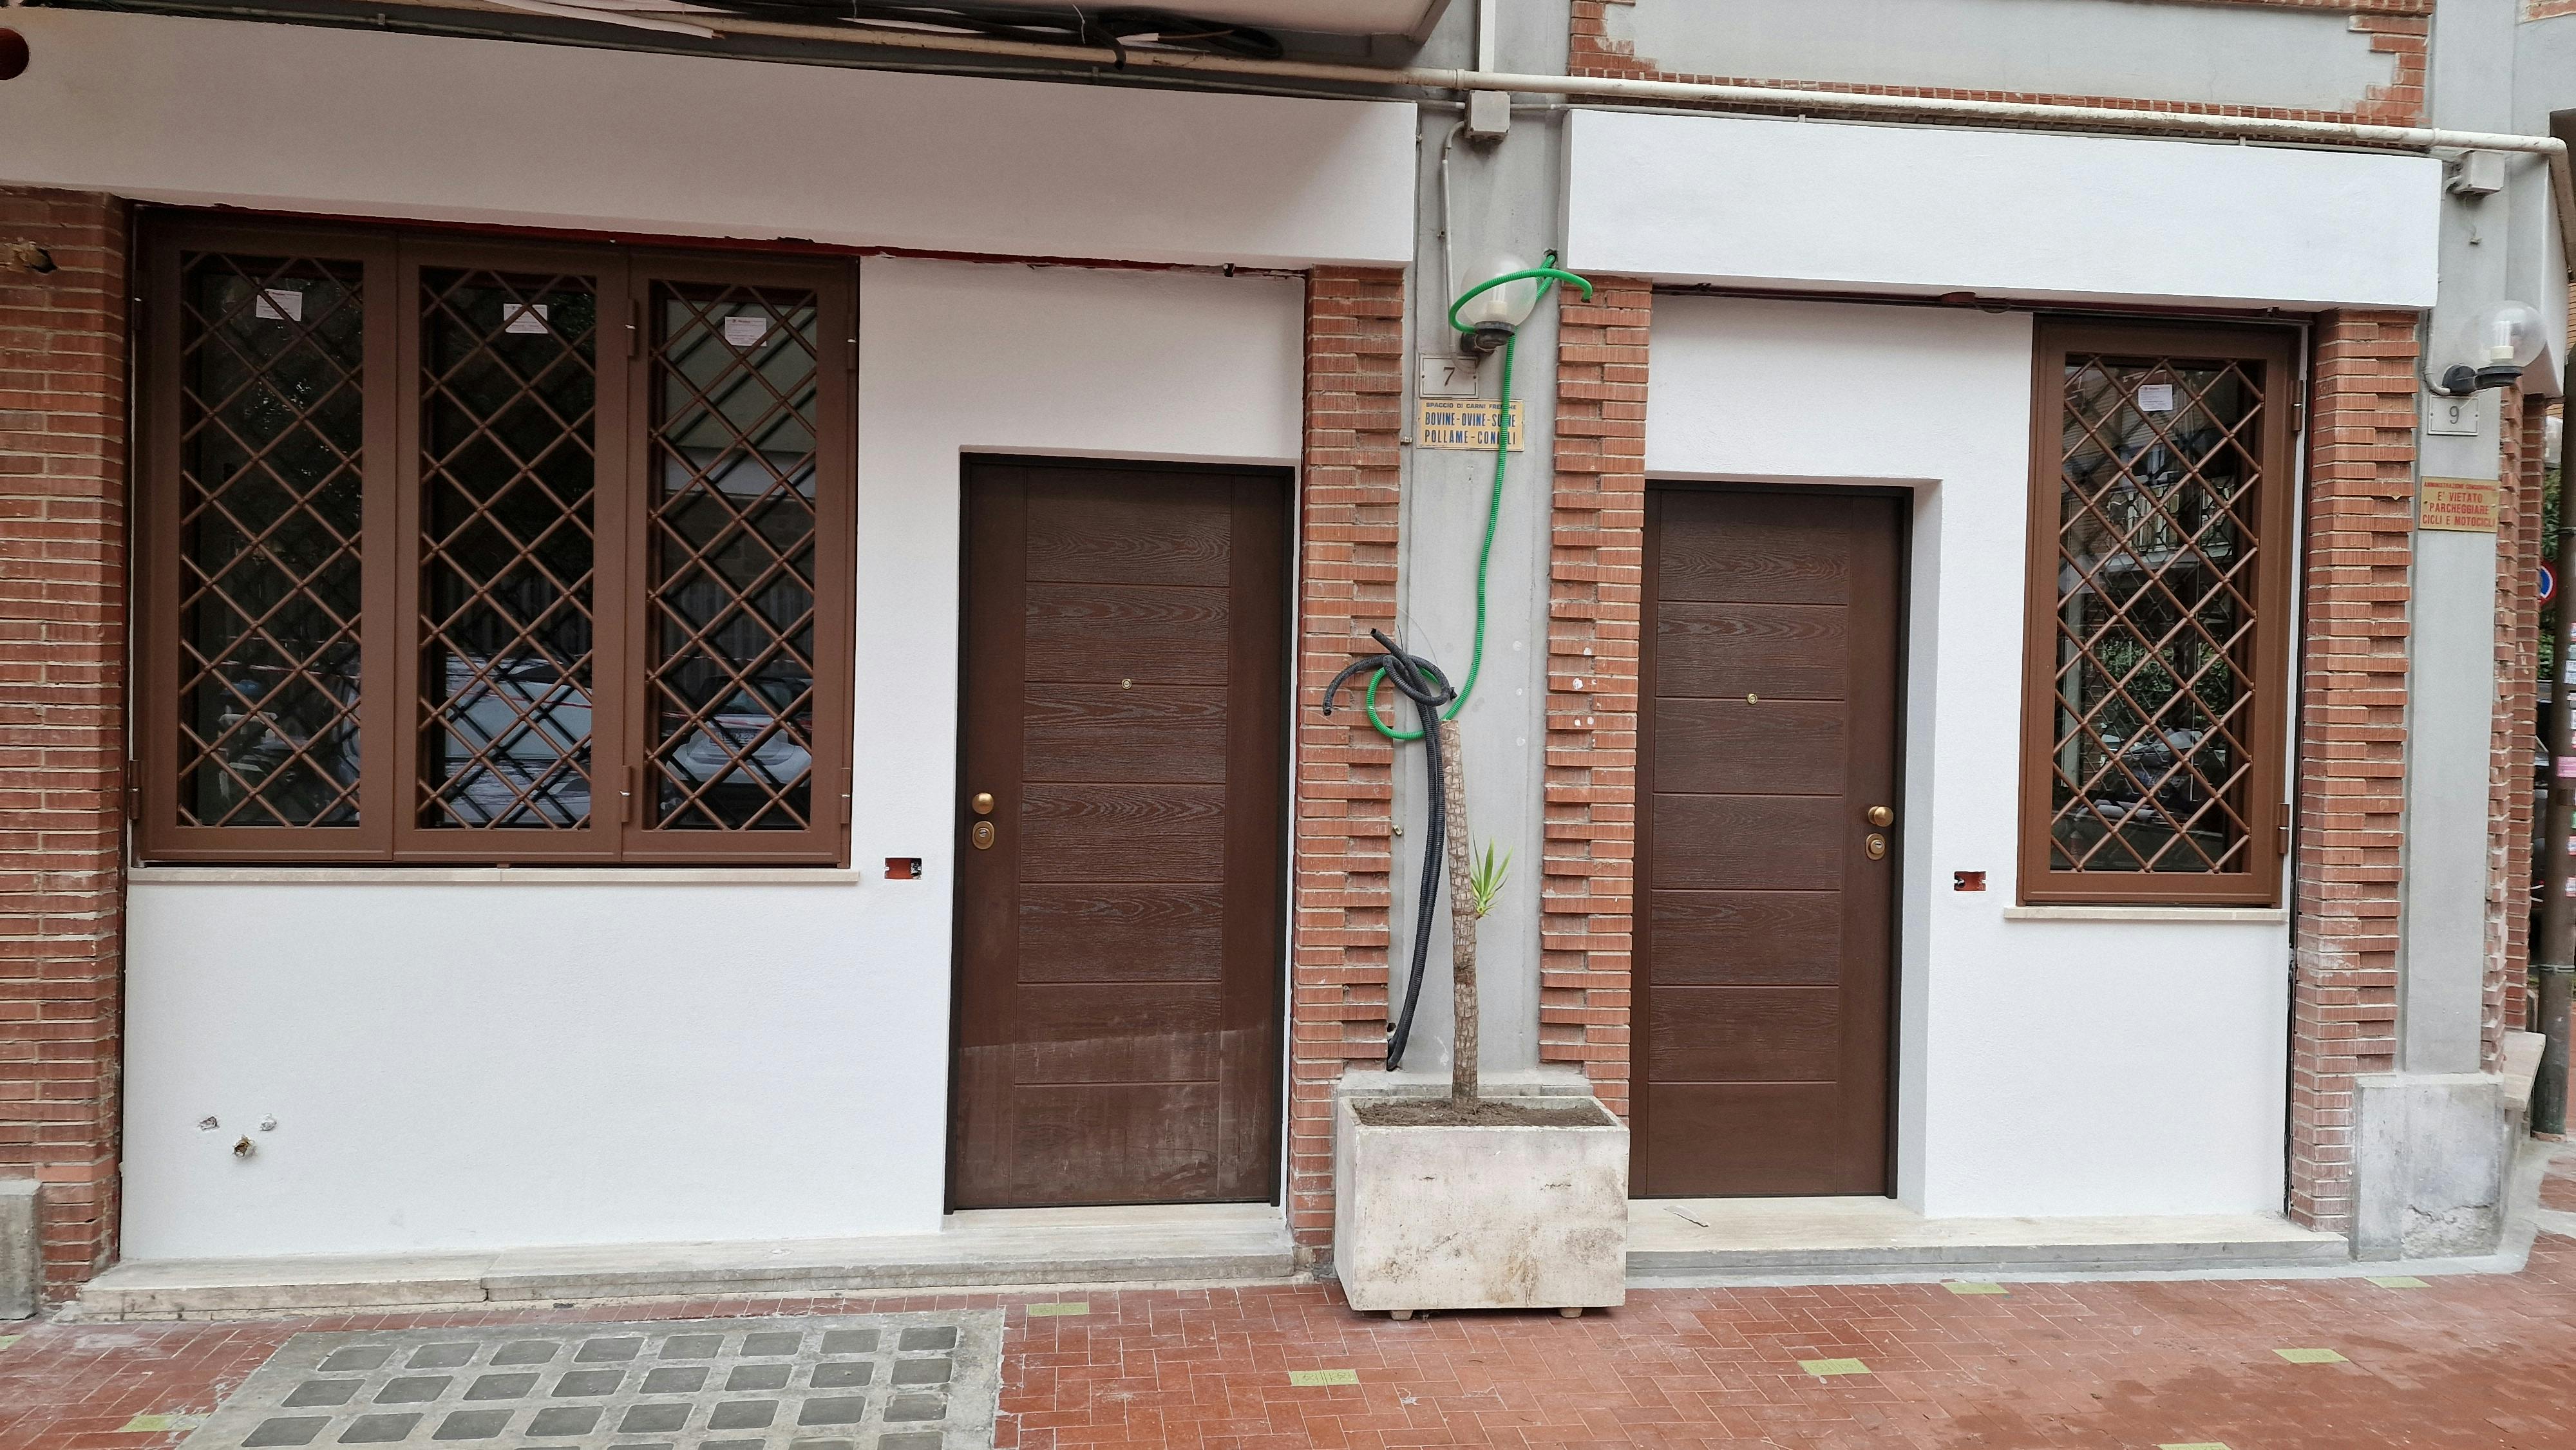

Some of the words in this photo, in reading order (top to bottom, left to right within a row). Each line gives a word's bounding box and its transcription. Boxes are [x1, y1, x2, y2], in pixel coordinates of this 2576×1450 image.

[1443, 367, 1455, 386] 7
[2449, 406, 2459, 424] 9
[2449, 492, 2483, 503] VIETATO
[2429, 502, 2489, 514] PARCHEGGIARE
[2422, 514, 2442, 525] CICLI
[2446, 516, 2450, 525] E
[2454, 516, 2496, 527] MOTOCICLI
